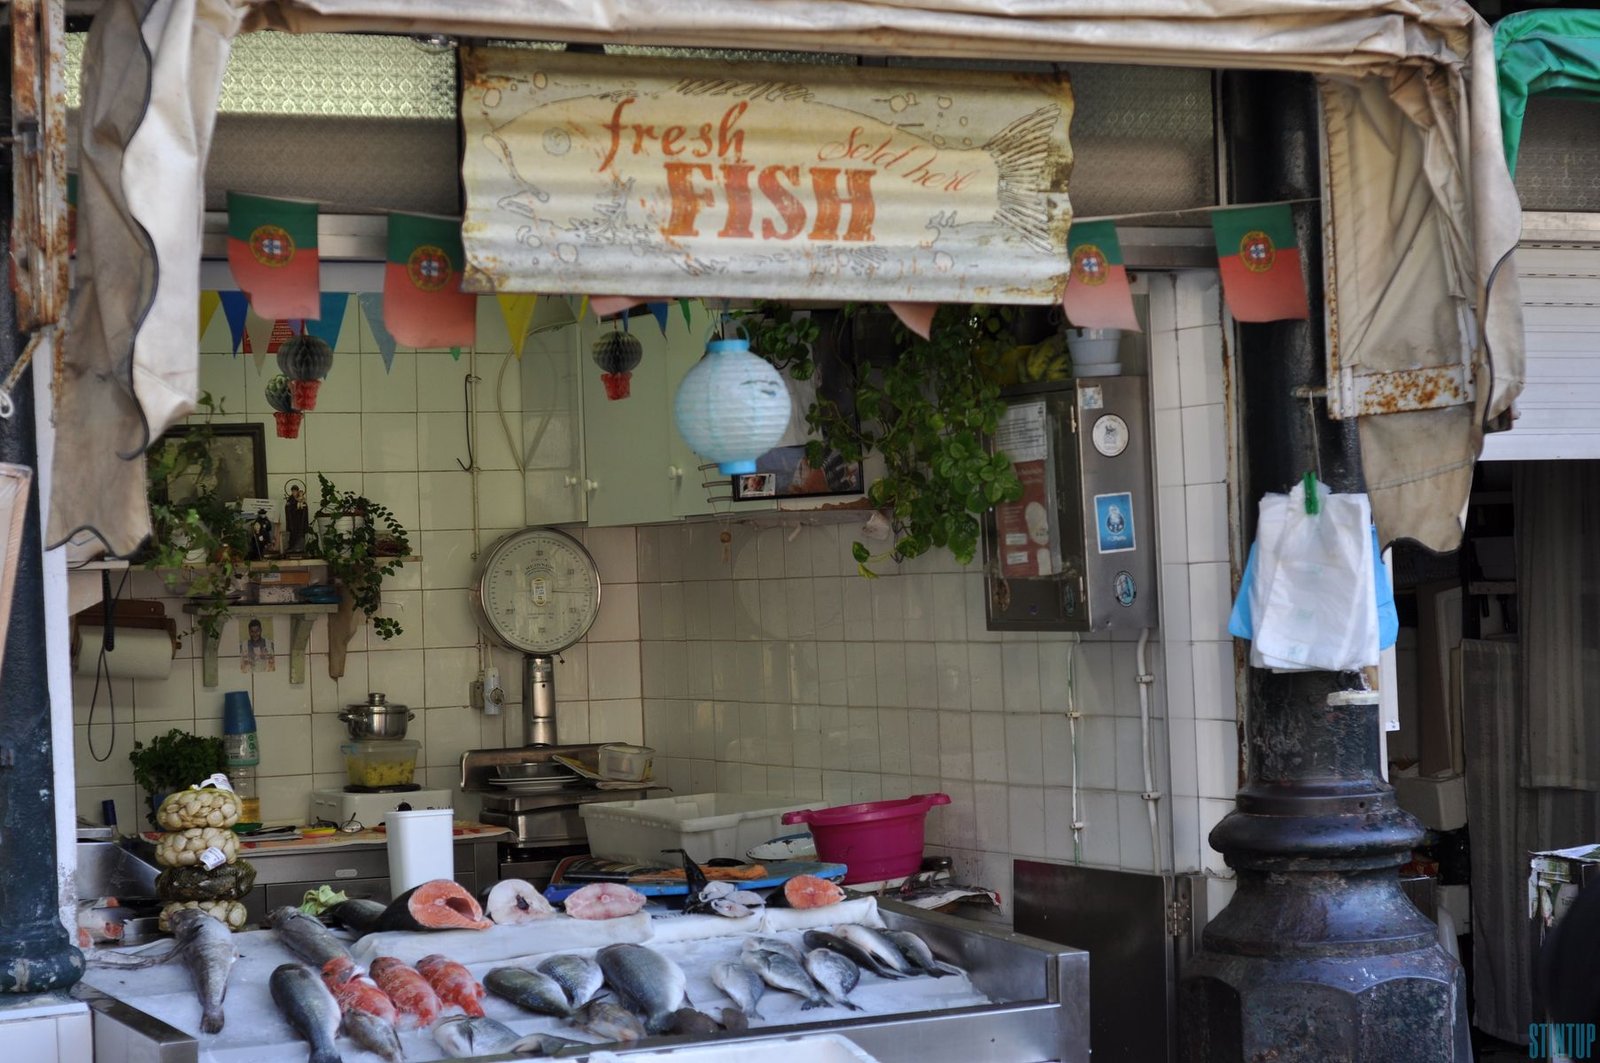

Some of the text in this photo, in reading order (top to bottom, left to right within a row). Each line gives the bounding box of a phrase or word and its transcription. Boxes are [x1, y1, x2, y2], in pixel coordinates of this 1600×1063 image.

[598, 97, 748, 173] fresh
[817, 126, 980, 192] Sold here
[660, 161, 877, 242] FISH
